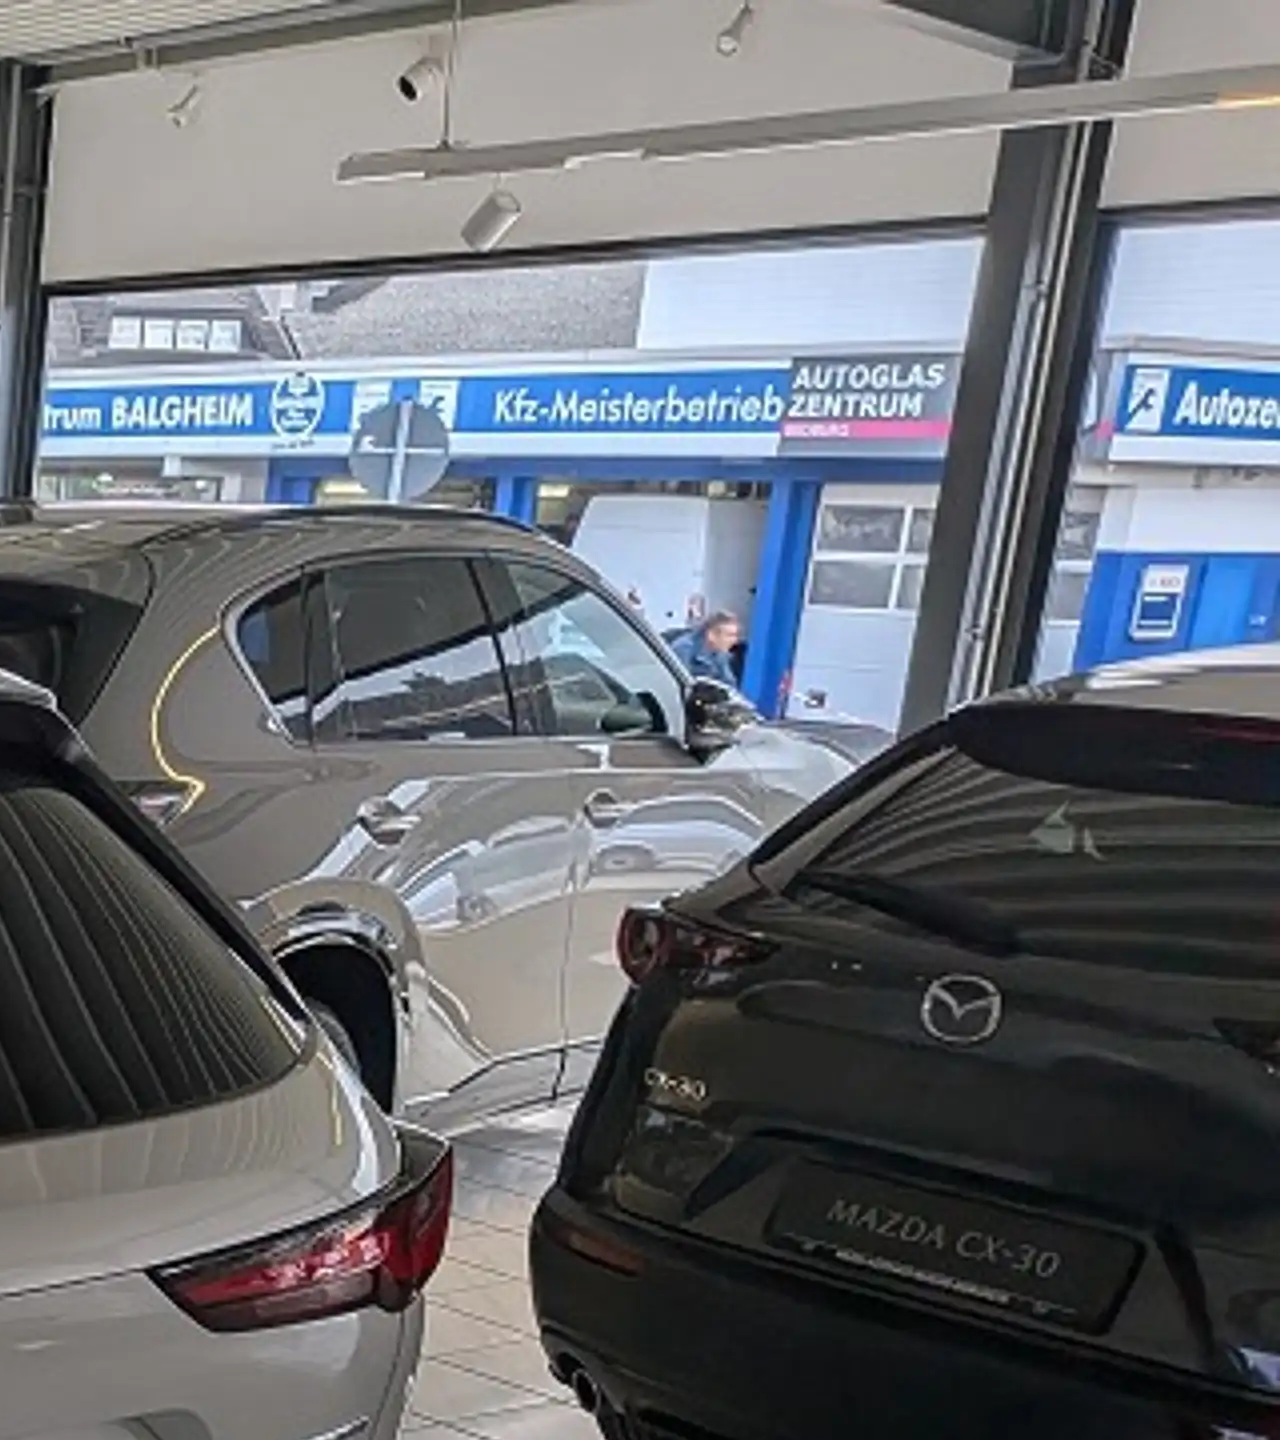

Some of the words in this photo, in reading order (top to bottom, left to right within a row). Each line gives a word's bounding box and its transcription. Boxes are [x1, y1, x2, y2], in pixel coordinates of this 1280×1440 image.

[792, 363, 947, 390] AUTOGLAS
[111, 393, 254, 430] BALGHEIM
[494, 384, 785, 423] Kfz-Meisterbetrieb
[787, 391, 925, 418] ZENTRUM
[1172, 379, 1280, 429] Autoze
[826, 1199, 946, 1250] MAZDA
[955, 1230, 1061, 1279] CX-30
